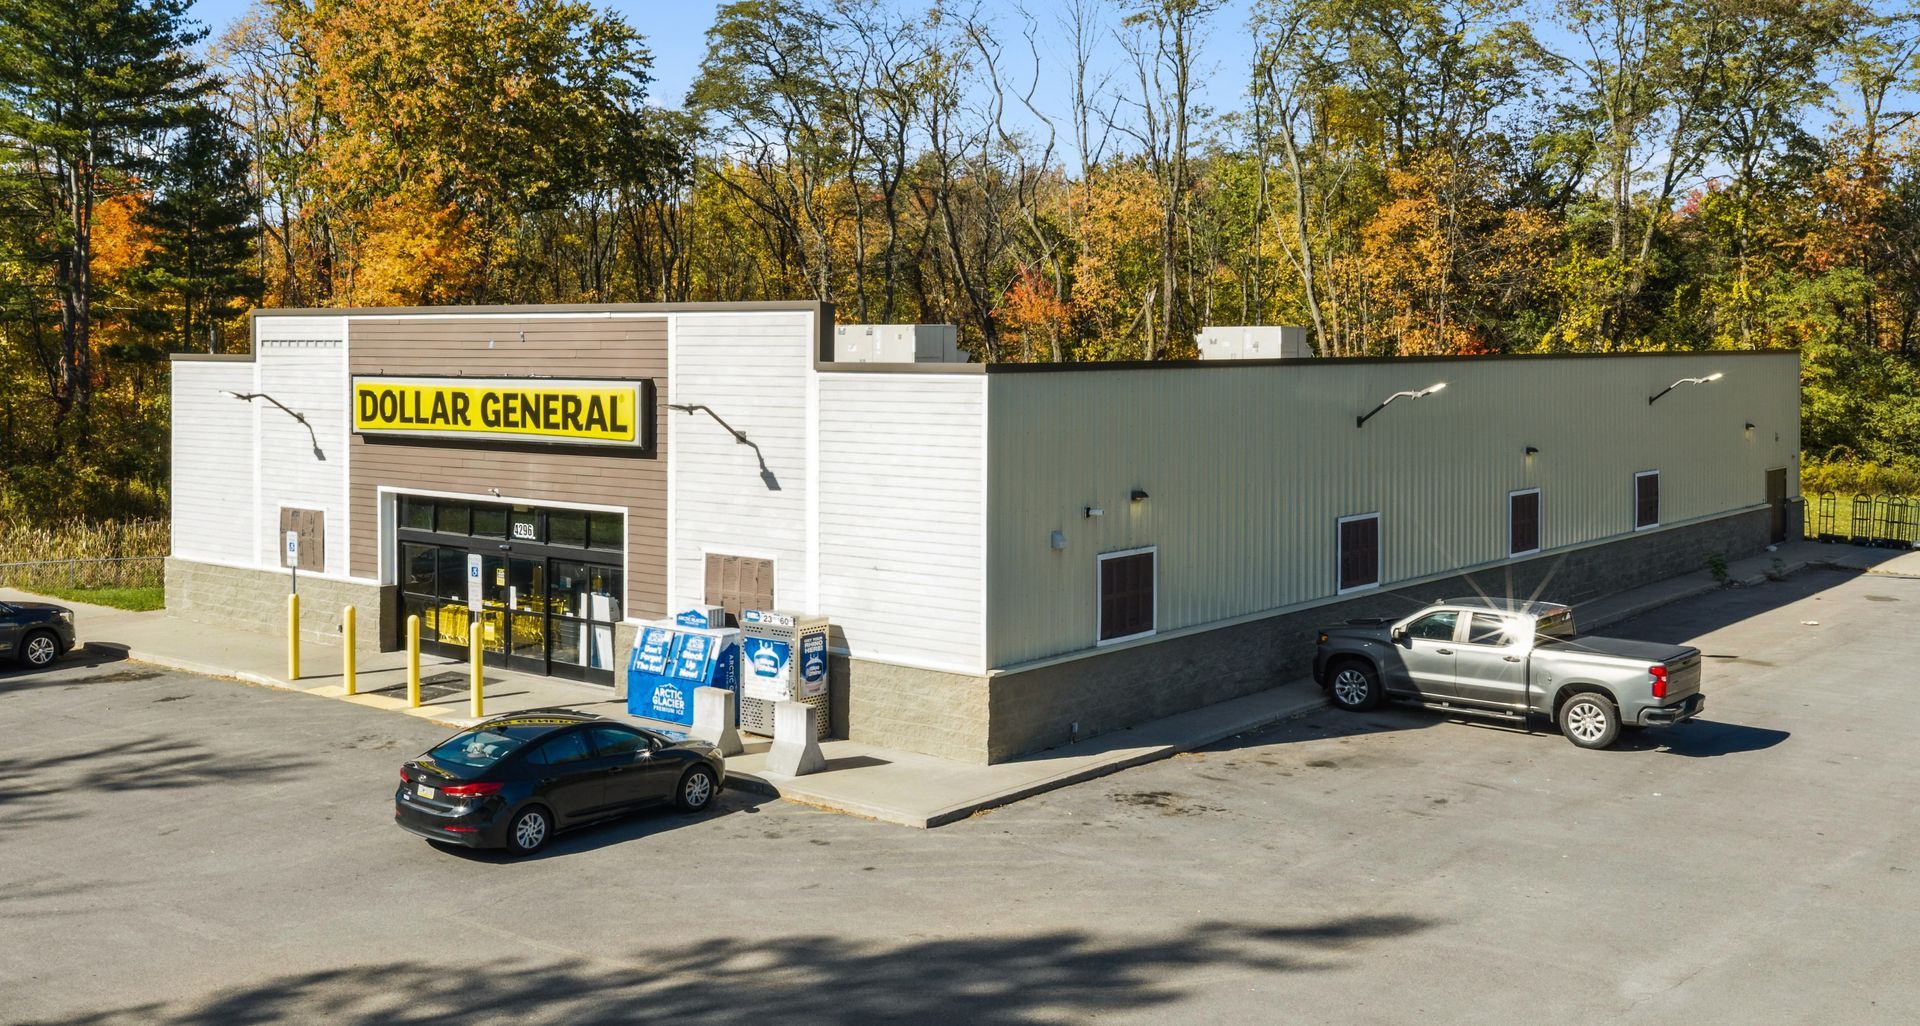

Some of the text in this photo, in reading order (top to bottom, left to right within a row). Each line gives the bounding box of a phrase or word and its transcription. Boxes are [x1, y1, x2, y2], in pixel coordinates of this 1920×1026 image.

[359, 389, 628, 433] DOLLAR GENERAL
[514, 524, 533, 537] 4296
[654, 687, 683, 700] ARCTIC
[652, 695, 685, 709] GLACIER
